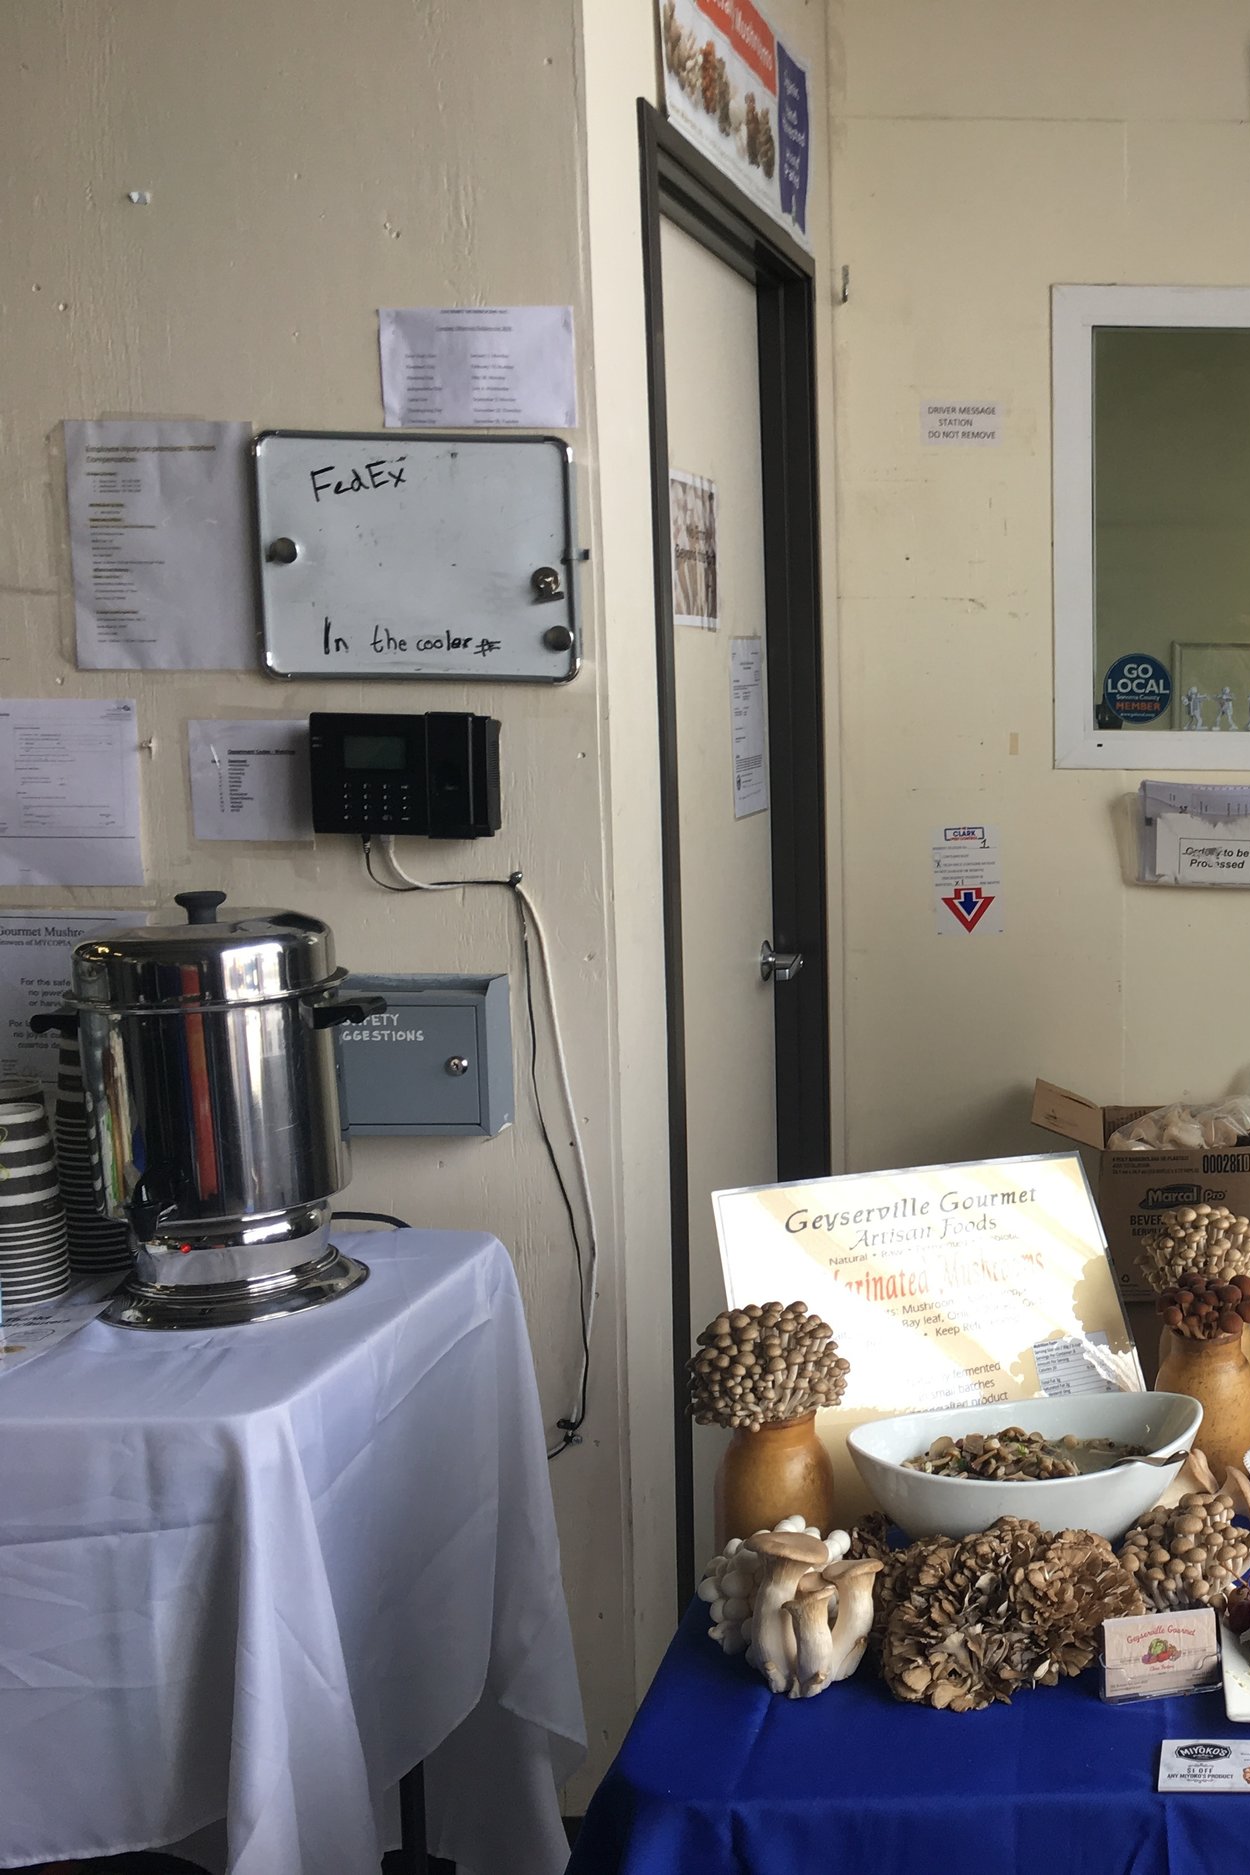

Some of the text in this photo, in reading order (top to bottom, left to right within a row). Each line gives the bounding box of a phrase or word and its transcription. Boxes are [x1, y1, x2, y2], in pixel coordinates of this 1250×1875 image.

[927, 406, 996, 415] DRIVER MESSAGE
[938, 418, 973, 427] STATION
[927, 430, 996, 440] DO NOT REMOVE
[310, 460, 407, 502] FedEx
[323, 616, 473, 655] In the cooler
[1123, 664, 1153, 678] GO
[1107, 679, 1170, 694] LOCAL
[1115, 702, 1161, 711] MEMBER
[952, 830, 976, 838] CLARK
[979, 839, 990, 849] 1
[1223, 848, 1234, 858] to
[1236, 848, 1250, 858] be
[1189, 858, 1245, 869] Procssed
[20, 977, 34, 986] For
[36, 978, 51, 986] the
[8, 1019, 23, 1028] Por
[1148, 1187, 1225, 1206] Marcal Pro
[784, 1187, 1038, 1234] Geyserville Gourmet
[849, 1226, 932, 1251] Artisan
[941, 1212, 998, 1240] Foods
[828, 1252, 868, 1266] Natural
[832, 1268, 930, 1303] arinated
[902, 1316, 922, 1329] Bay
[934, 1325, 961, 1338] Keep
[952, 1361, 1001, 1378] fermented
[957, 1378, 996, 1394] batches
[970, 1391, 1009, 1409] product
